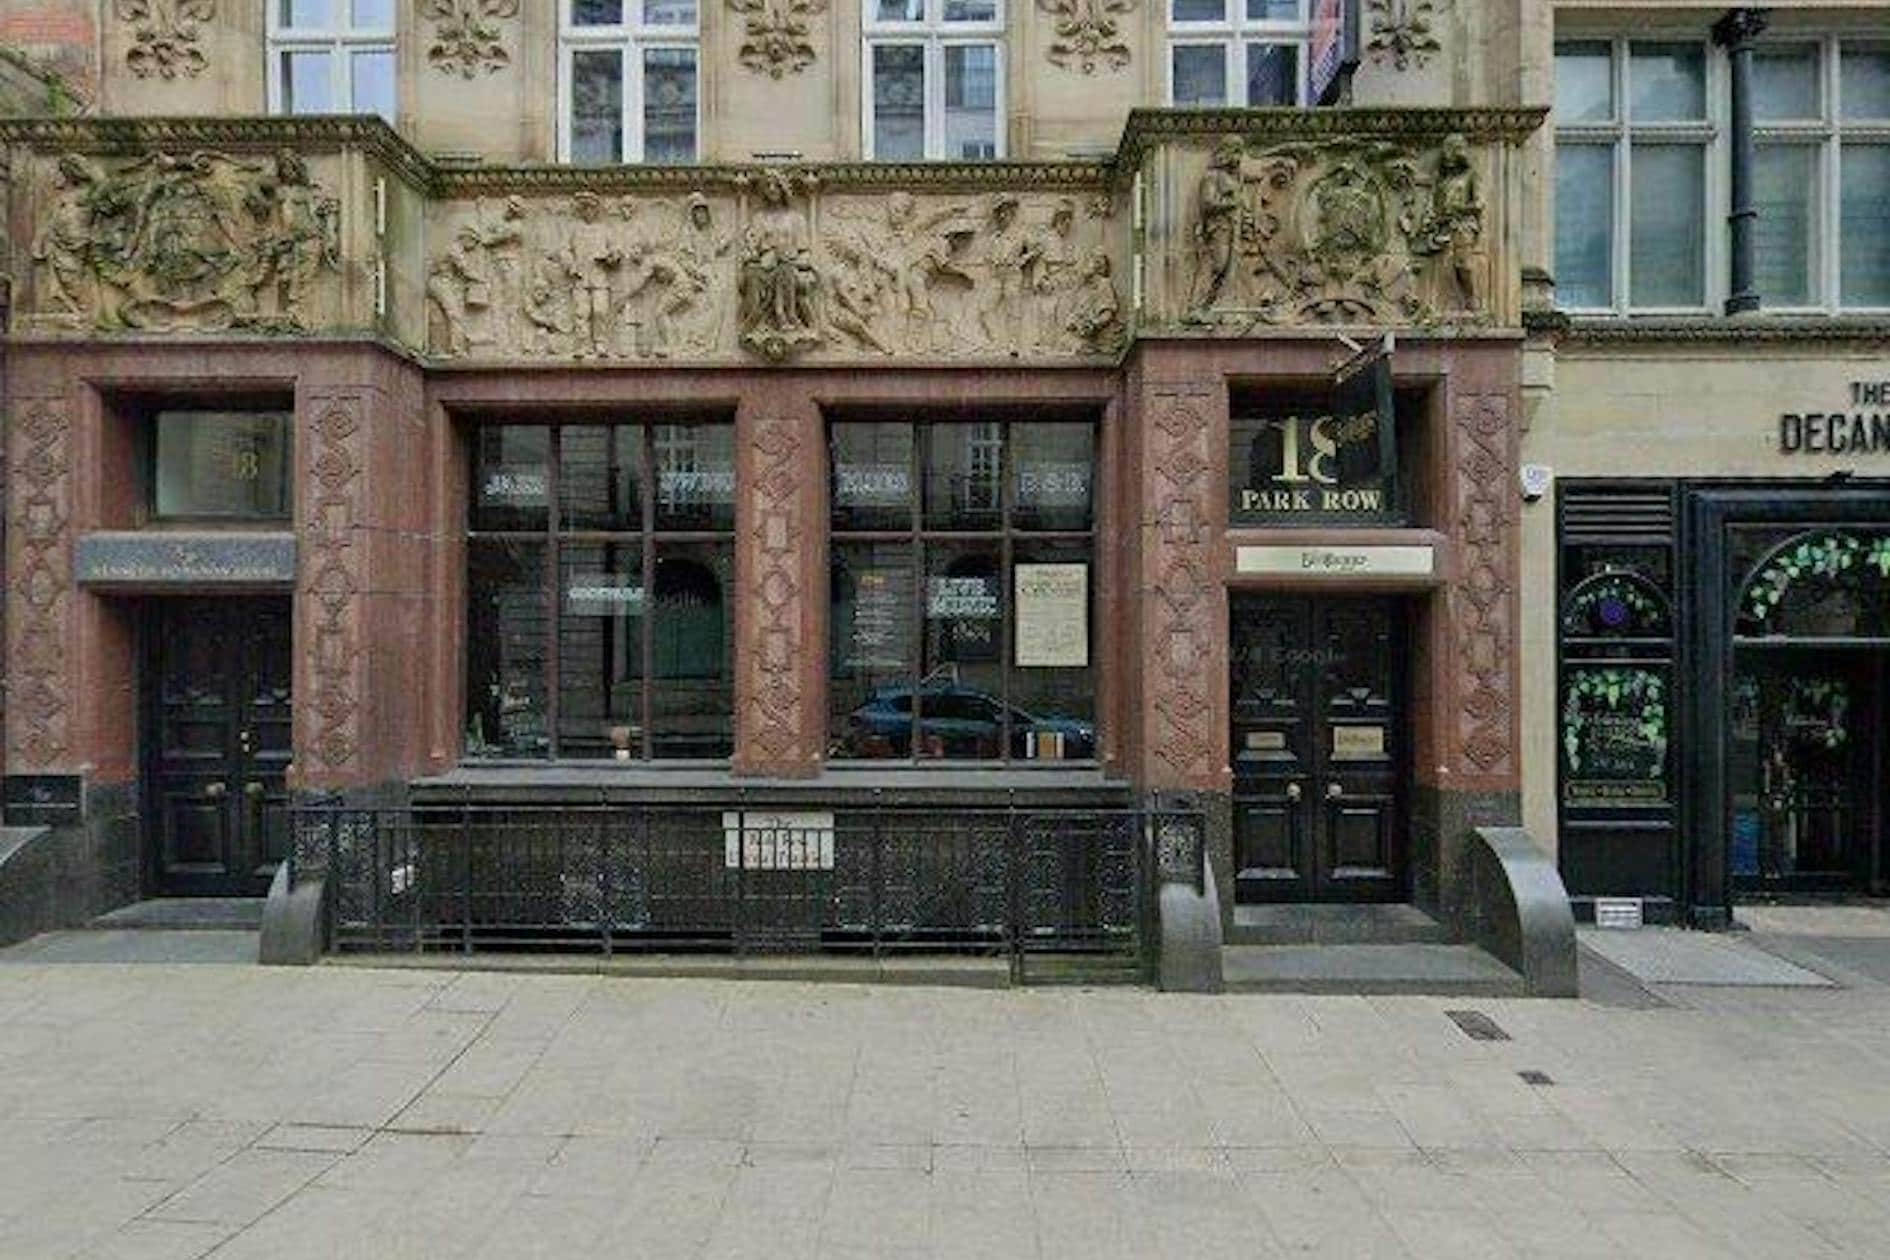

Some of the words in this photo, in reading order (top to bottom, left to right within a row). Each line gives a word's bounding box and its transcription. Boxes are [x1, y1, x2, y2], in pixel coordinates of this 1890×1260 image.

[1850, 381, 1890, 404] THE
[1781, 414, 1890, 451] DECAN
[1241, 488, 1310, 511] PARK
[1322, 488, 1381, 511] ROW
